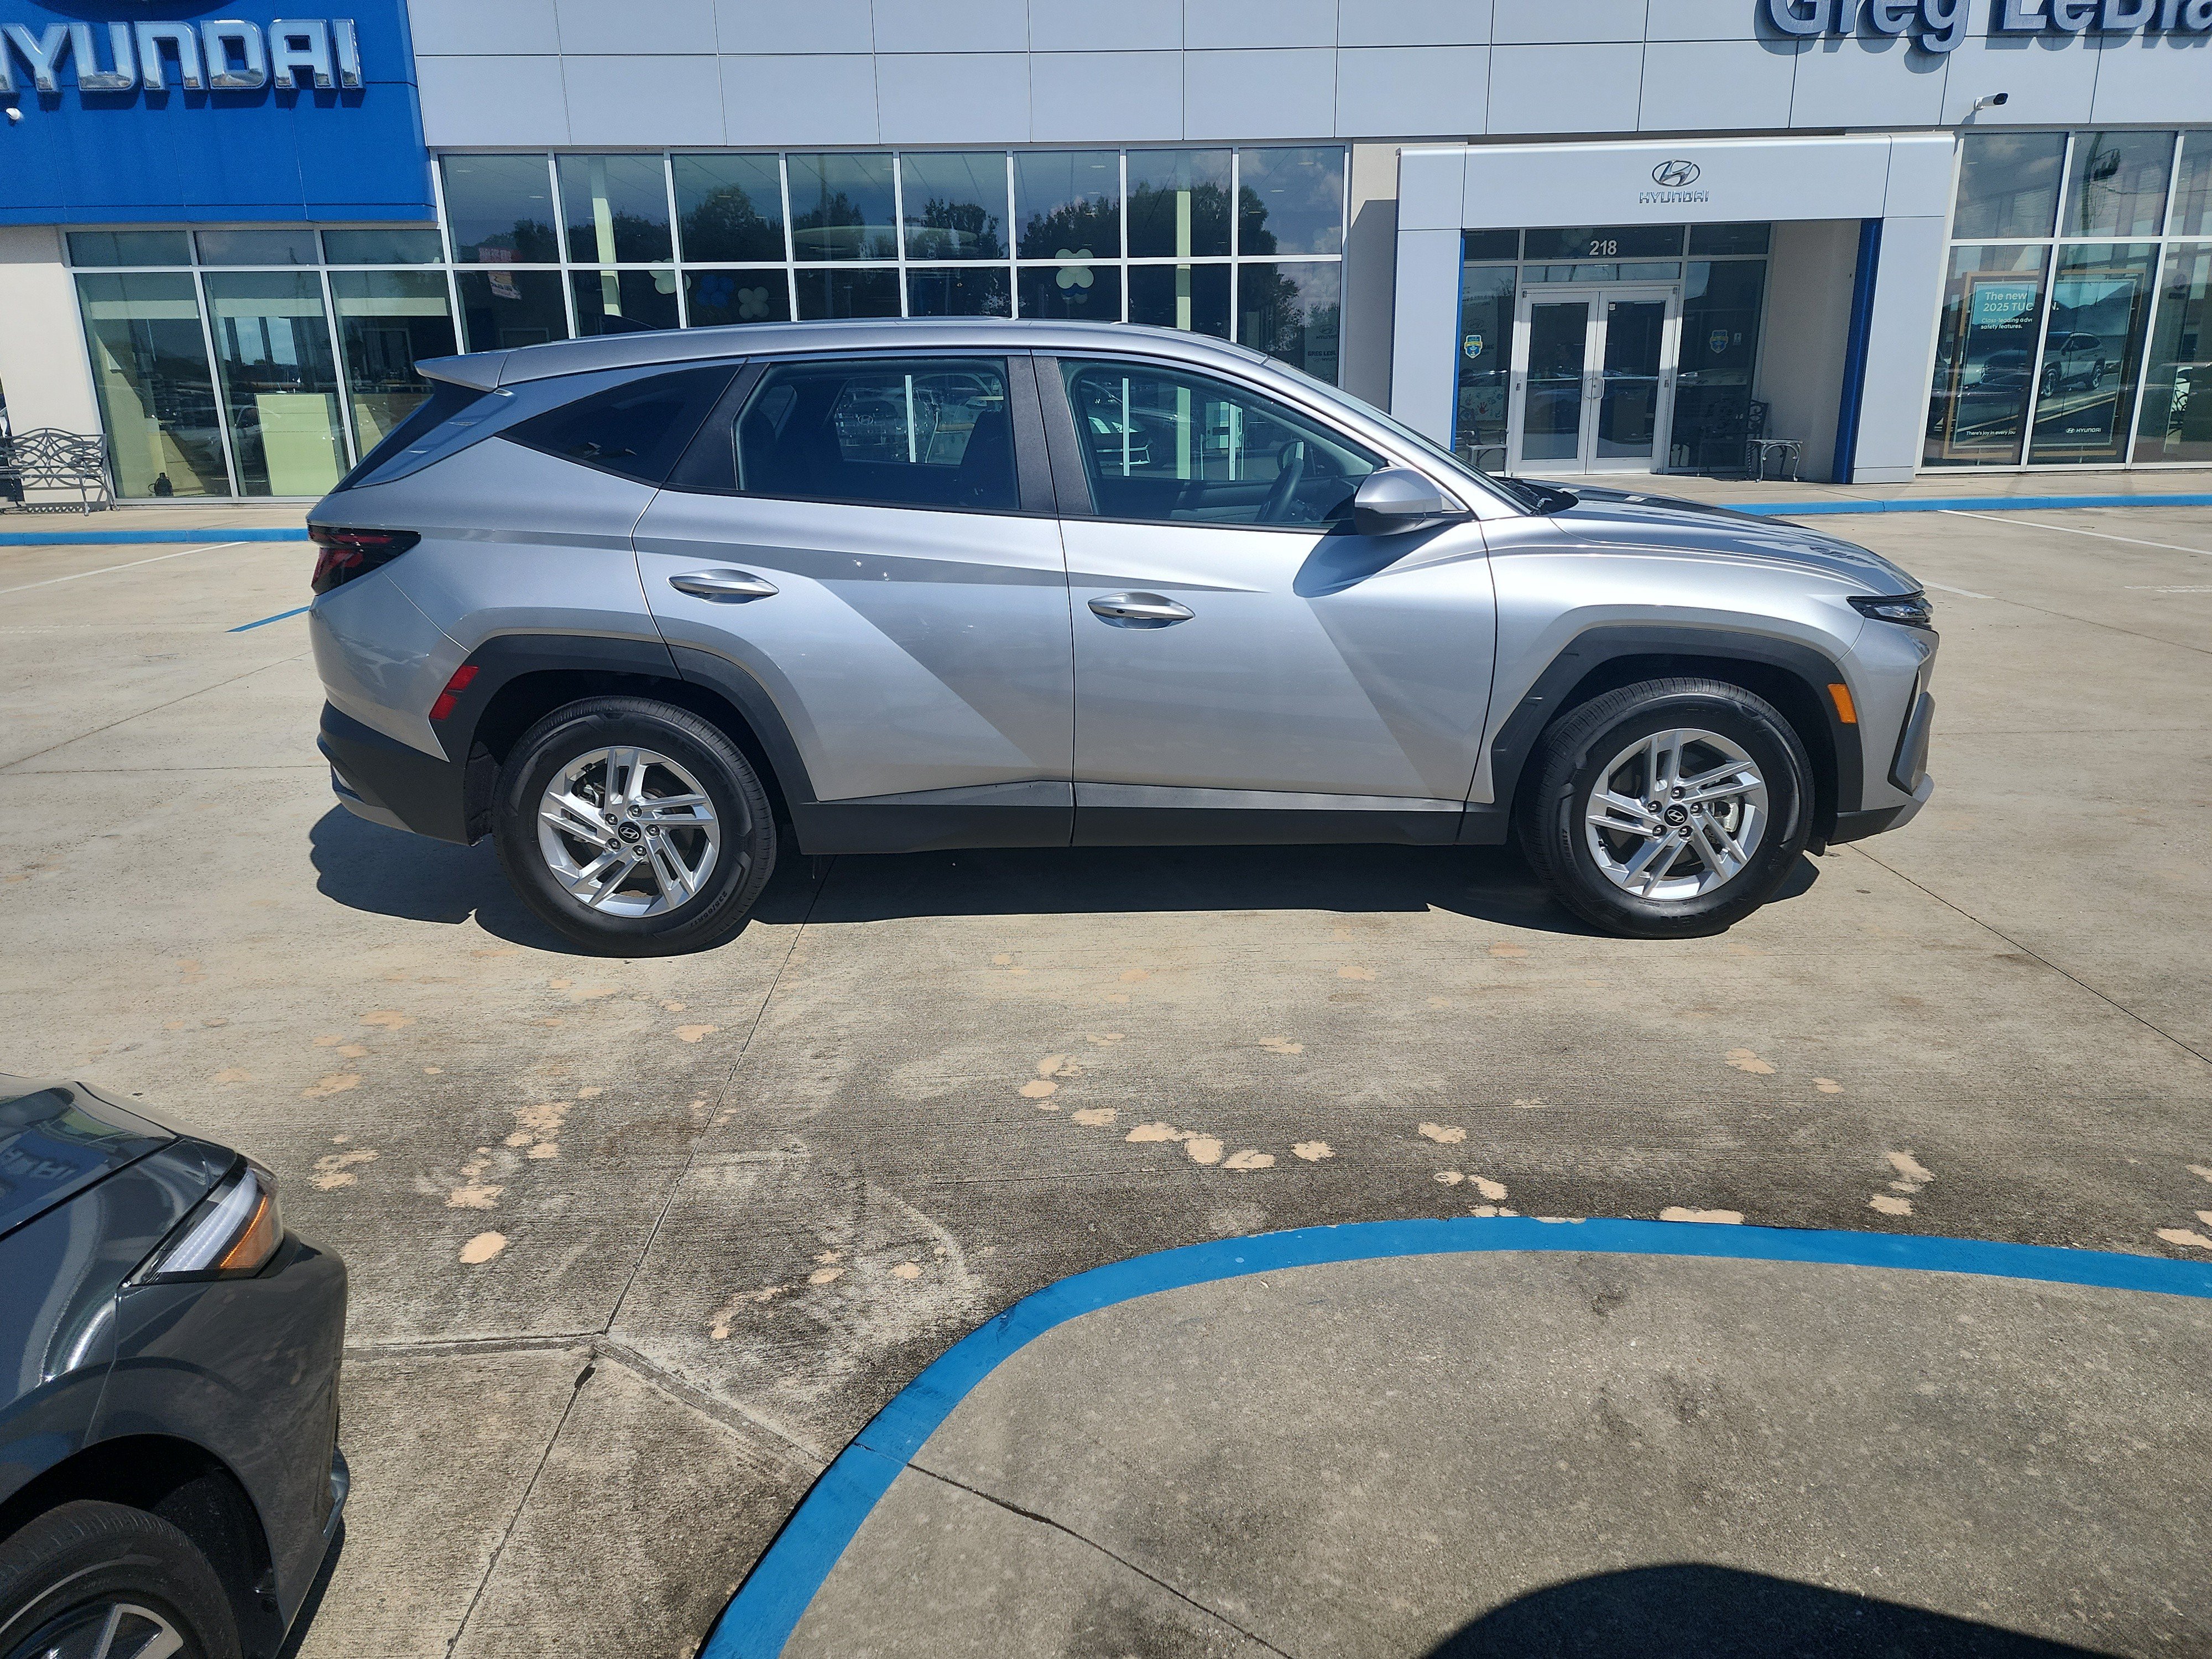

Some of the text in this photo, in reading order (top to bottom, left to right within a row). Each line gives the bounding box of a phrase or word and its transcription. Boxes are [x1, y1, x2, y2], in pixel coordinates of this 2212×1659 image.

[0, 19, 365, 93] YUNDAI
[1639, 190, 1709, 204] HYUNDAI
[1589, 240, 1617, 255] 218
[1985, 291, 2004, 300] The
[1983, 302, 2009, 311] 2025
